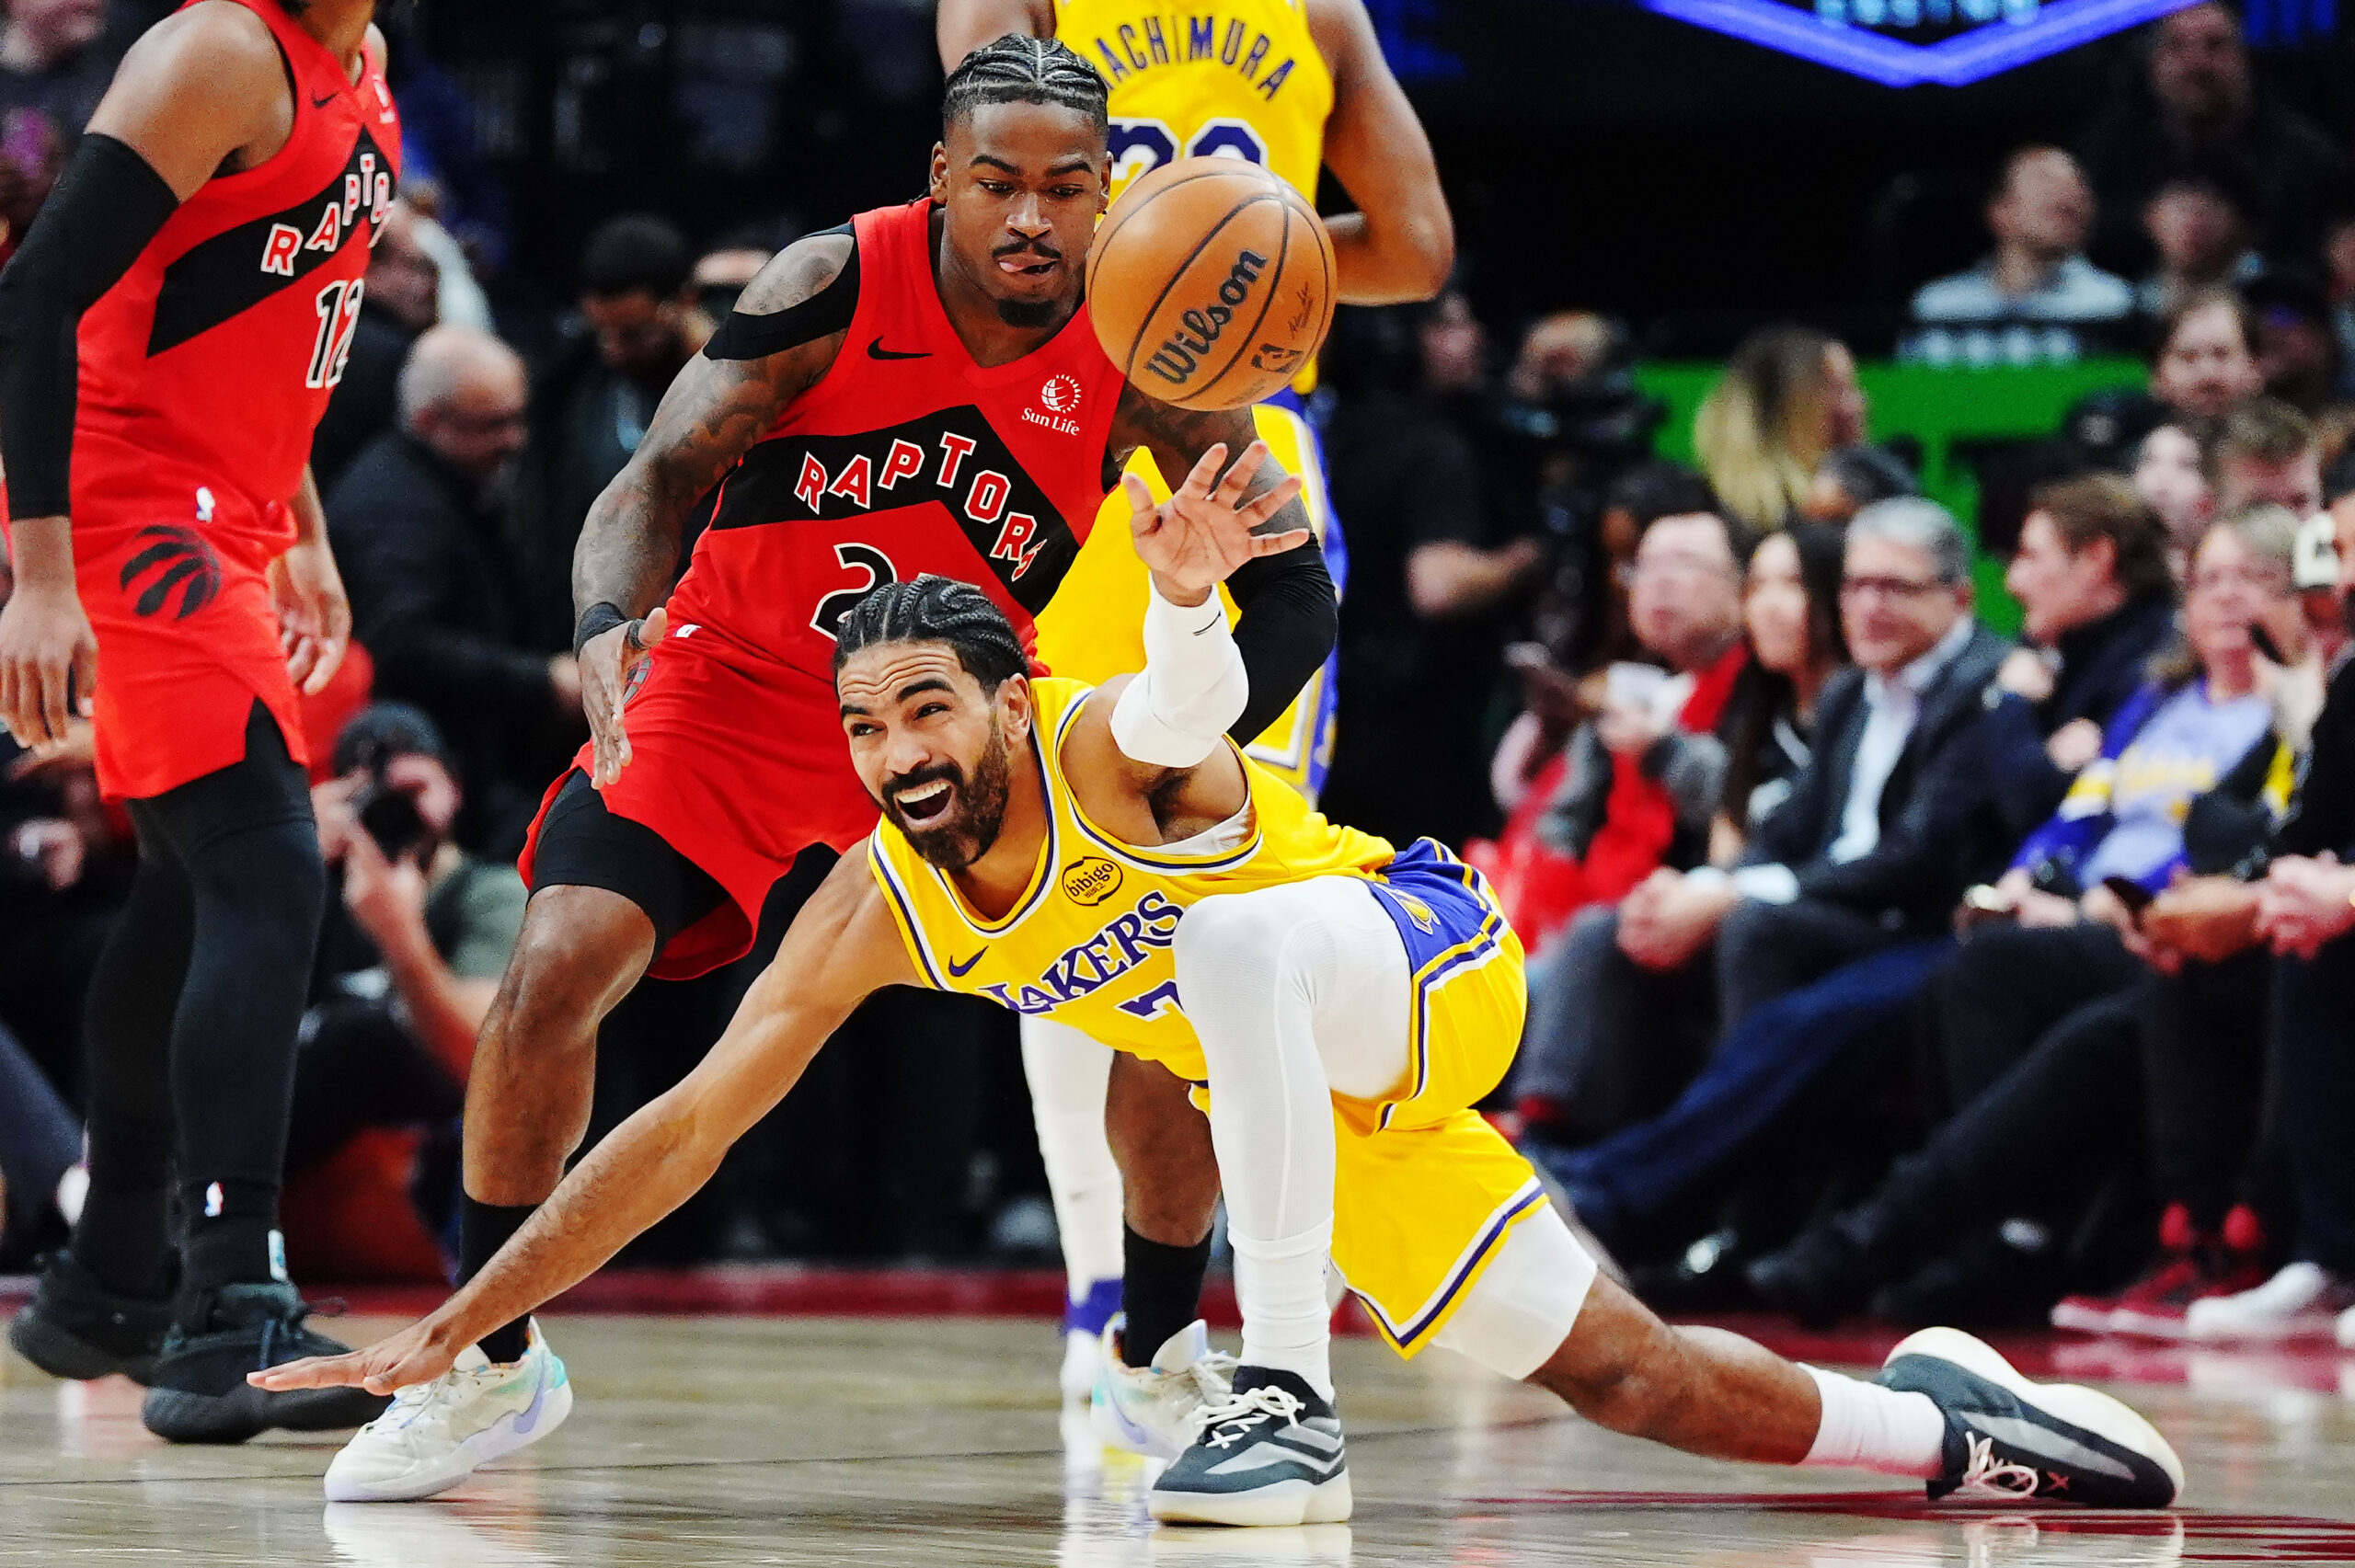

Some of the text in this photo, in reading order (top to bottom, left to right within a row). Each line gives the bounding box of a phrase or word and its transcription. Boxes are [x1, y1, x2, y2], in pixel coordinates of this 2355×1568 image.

[1143, 247, 1269, 385] Wilson
[1021, 407, 1081, 437] Sun Life
[1065, 863, 1114, 898] bibigo
[976, 889, 1185, 1015] LAKERS
